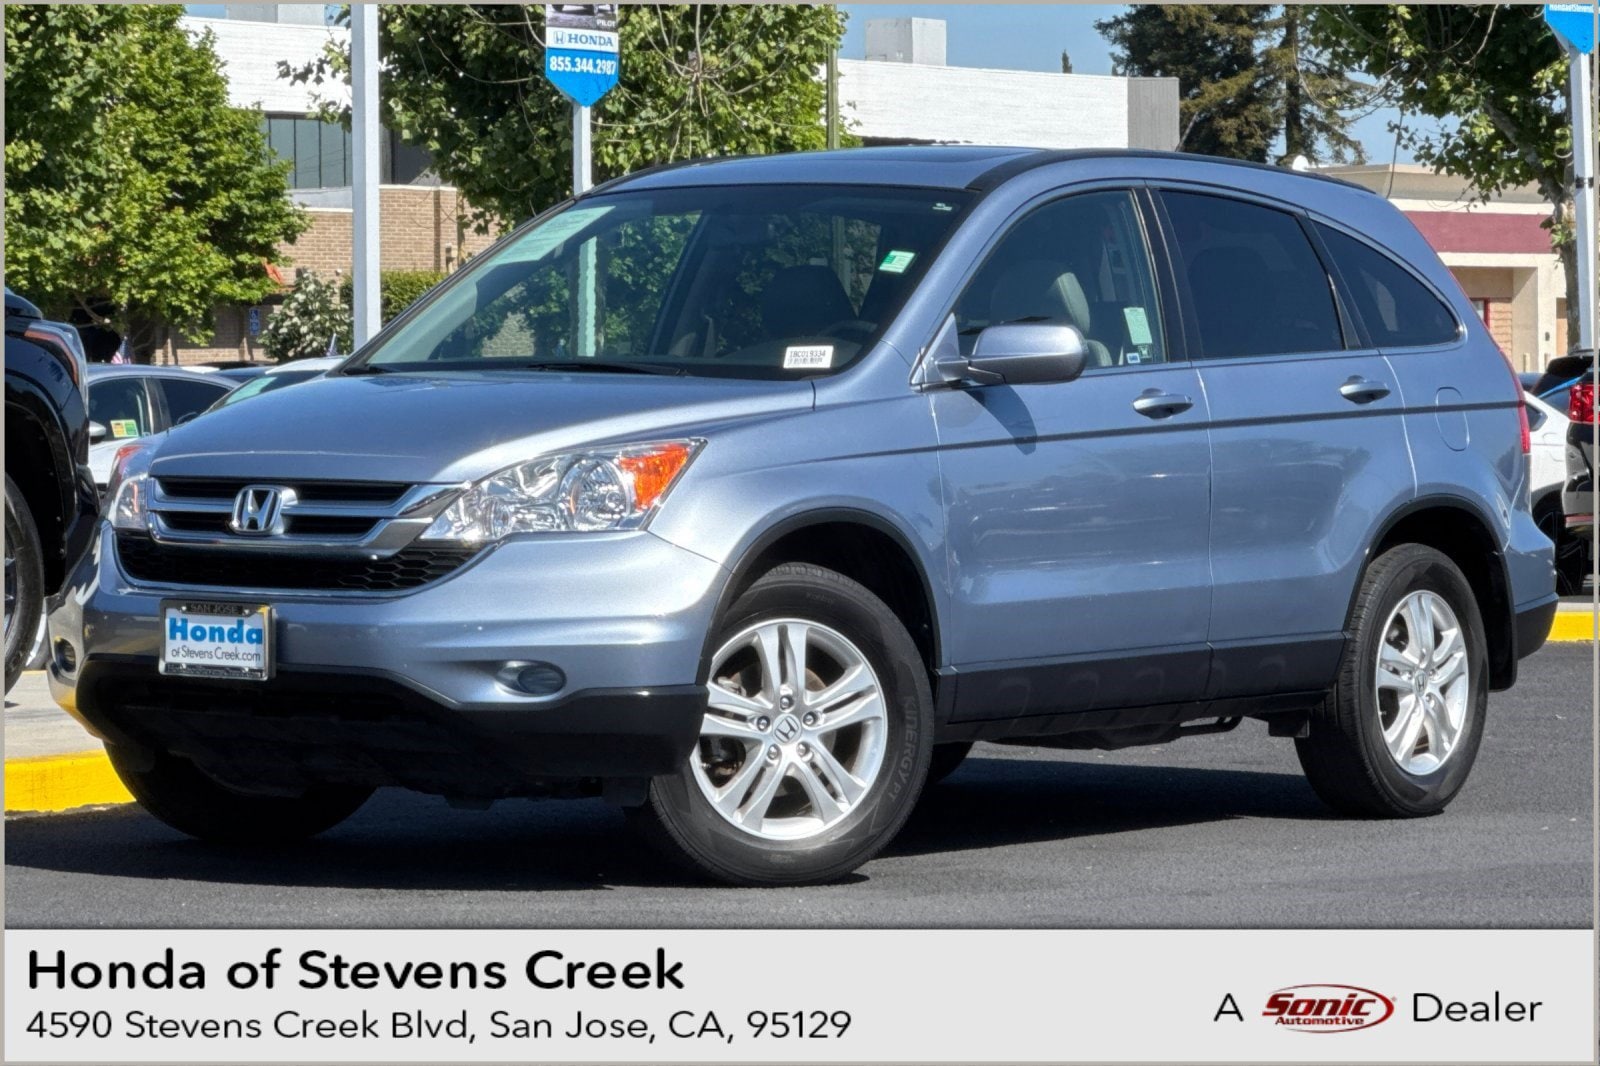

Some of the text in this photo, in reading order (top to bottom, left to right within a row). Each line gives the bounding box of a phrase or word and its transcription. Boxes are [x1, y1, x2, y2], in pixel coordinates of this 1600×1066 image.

[567, 33, 614, 47] HONDA
[549, 55, 617, 75] 855.344.2987
[168, 617, 263, 645] Honda
[171, 645, 261, 661] of Stevens Creek.com
[898, 696, 918, 785] KINERGY
